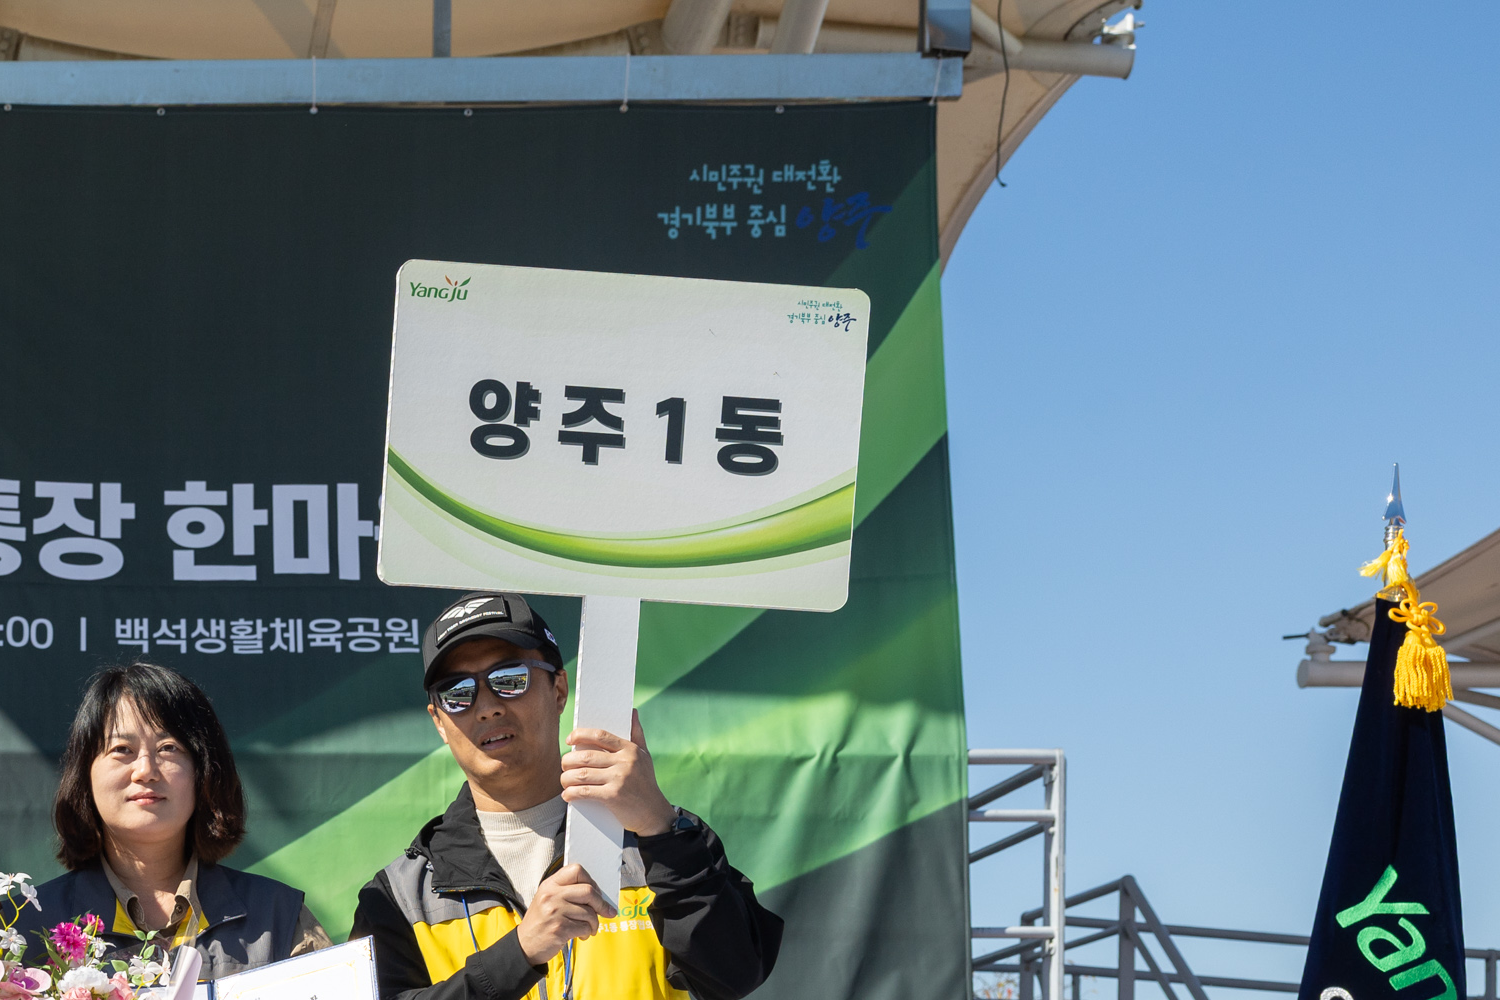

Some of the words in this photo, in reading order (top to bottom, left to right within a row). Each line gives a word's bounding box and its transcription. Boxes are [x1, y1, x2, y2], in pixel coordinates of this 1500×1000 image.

[689, 163, 765, 195] 시민주권
[771, 160, 842, 194] 대전환
[657, 203, 738, 241] 경기북부
[746, 203, 787, 239] 중심
[795, 191, 894, 251] 양주
[827, 312, 858, 333] 양주
[163, 480, 382, 581] 한마
[114, 616, 421, 654] 백석생활체육공원
